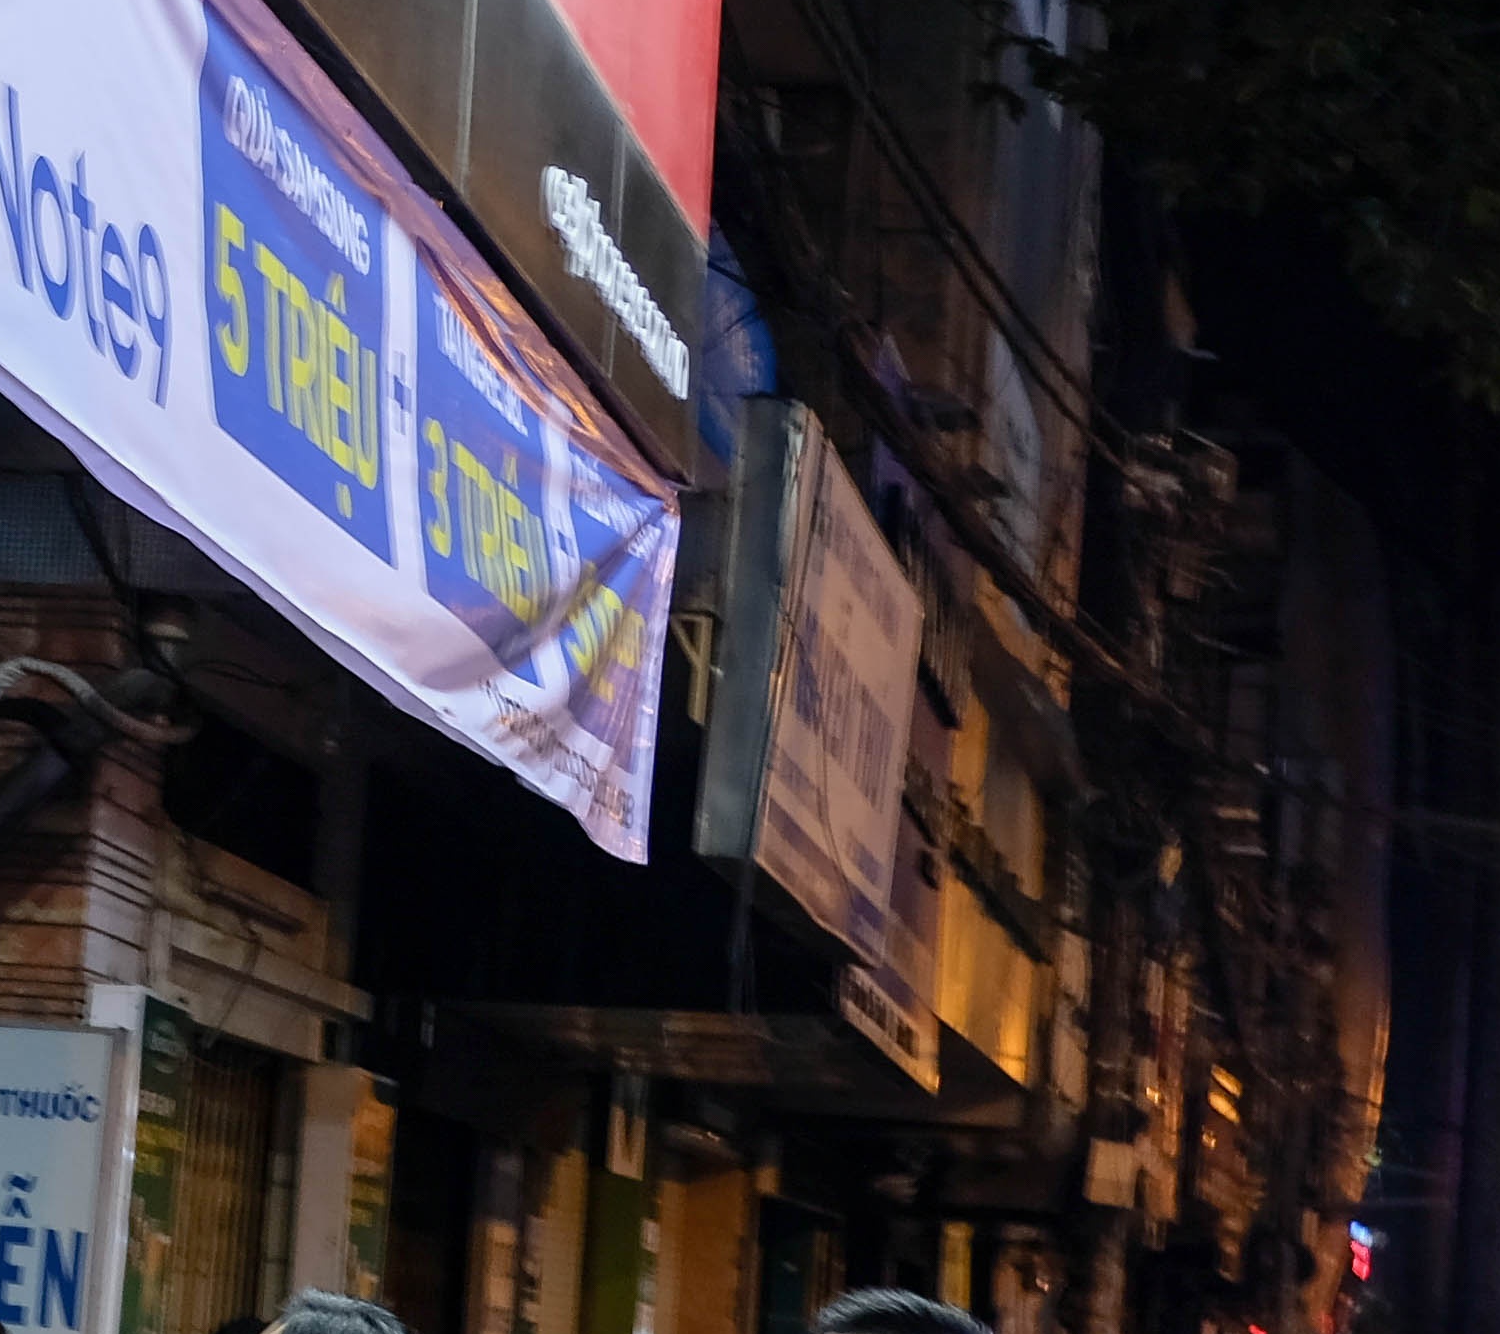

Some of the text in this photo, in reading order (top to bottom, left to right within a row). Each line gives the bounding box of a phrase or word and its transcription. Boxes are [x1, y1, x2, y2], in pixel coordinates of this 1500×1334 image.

[213, 203, 380, 520] 5 TRIỆU
[423, 418, 452, 559] 3
